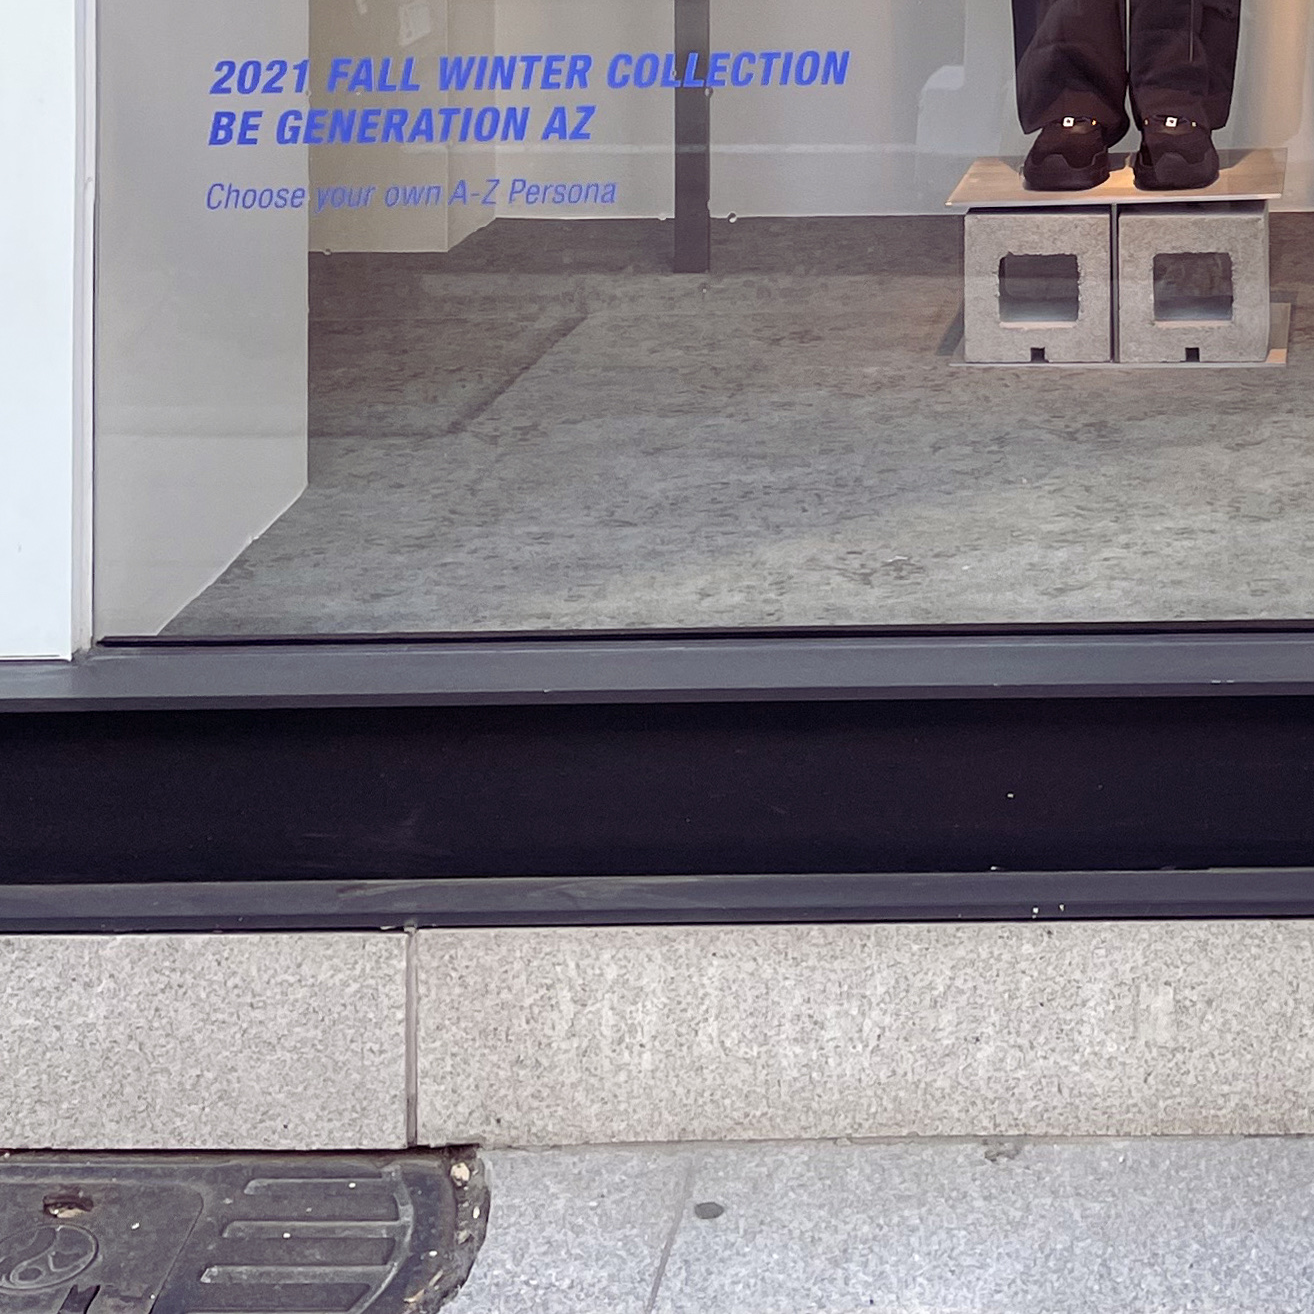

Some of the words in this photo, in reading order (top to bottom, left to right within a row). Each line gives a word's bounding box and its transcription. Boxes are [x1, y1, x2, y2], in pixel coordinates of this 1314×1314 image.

[209, 60, 310, 94] 2021
[326, 56, 421, 92] FALL
[438, 54, 592, 91] WINTER
[607, 50, 850, 88] COLLECTION
[208, 110, 264, 146] BE
[276, 106, 531, 145] GENERATION
[541, 105, 597, 141] AZ
[206, 183, 306, 210] Choose
[314, 186, 376, 214] your
[384, 186, 442, 207] own
[448, 178, 500, 206] A-Z
[508, 178, 617, 205] Persona
